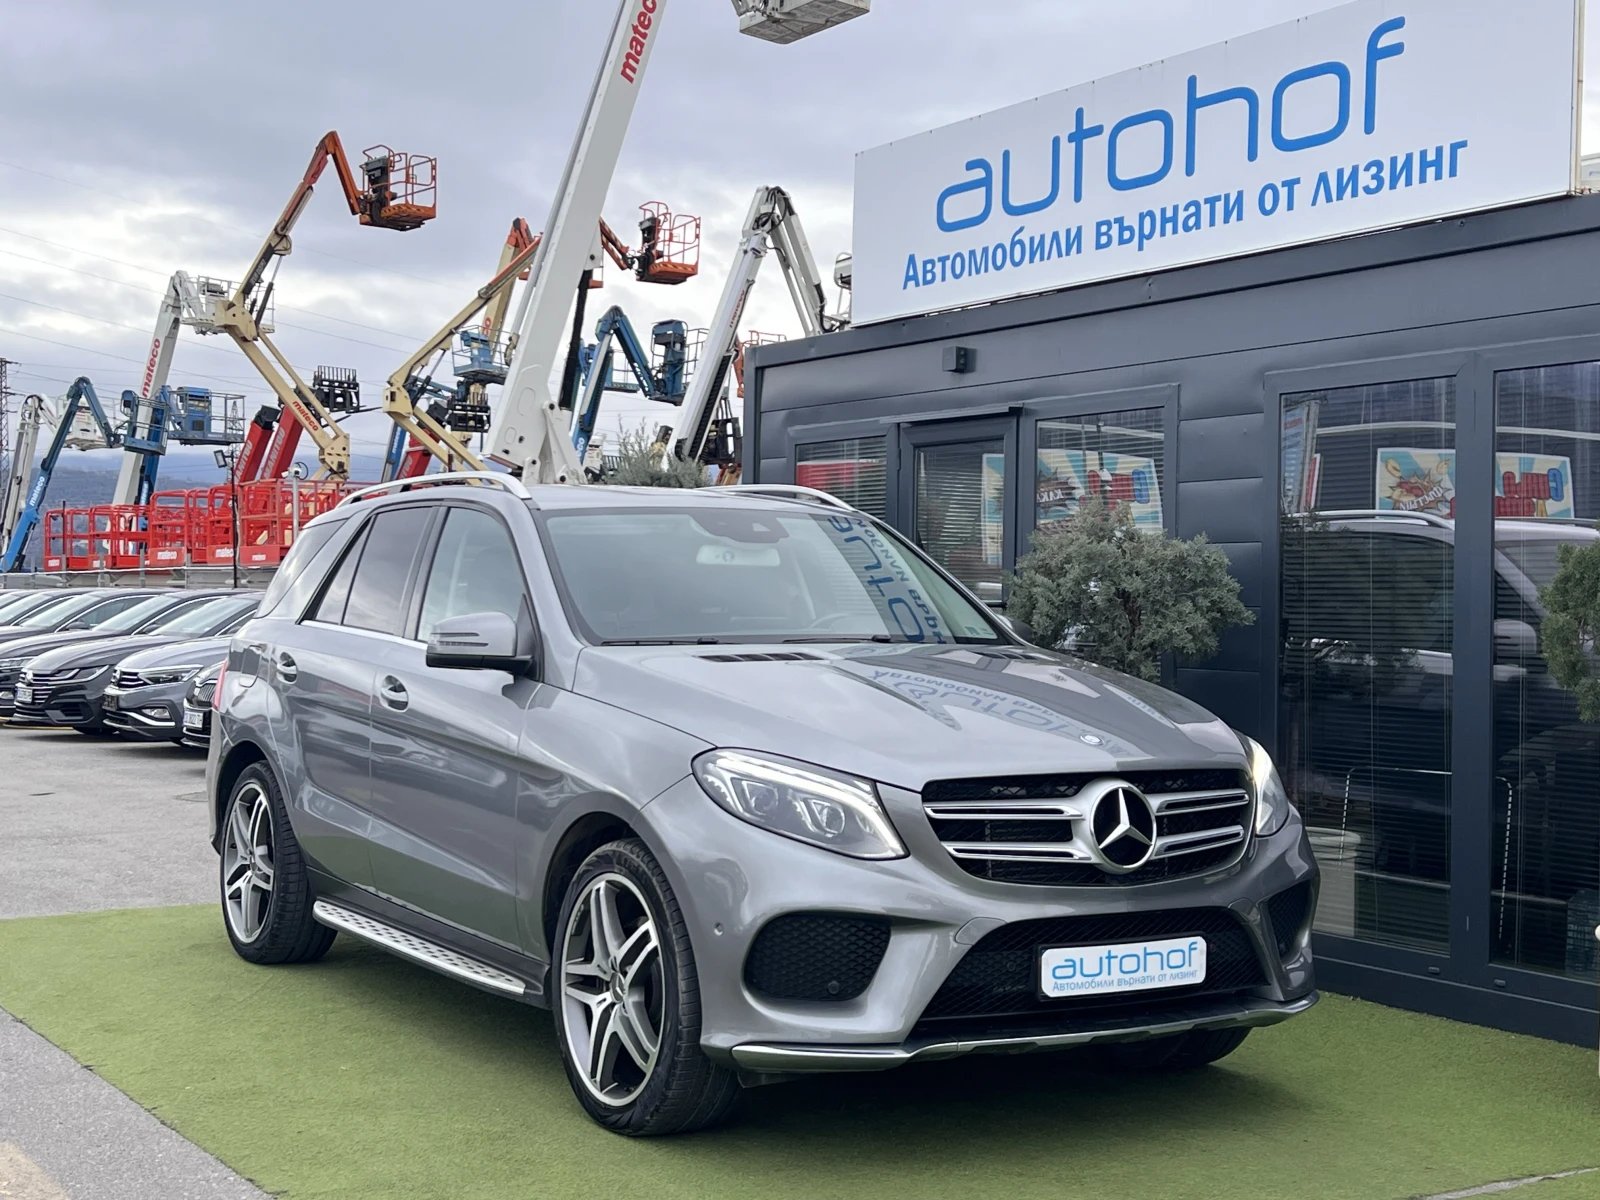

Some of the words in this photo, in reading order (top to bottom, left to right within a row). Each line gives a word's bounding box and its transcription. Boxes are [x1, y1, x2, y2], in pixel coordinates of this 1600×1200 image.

[937, 17, 1405, 232] autohof
[903, 226, 1082, 289] Автомобили
[1095, 190, 1243, 251] върнати
[1258, 178, 1301, 217] от
[1312, 140, 1468, 207] лизинг
[142, 338, 160, 398] mateco
[292, 401, 319, 431] mateco
[29, 476, 45, 506] mateco
[1052, 941, 1198, 980] autohof
[1053, 978, 1114, 991] Автомобили
[1117, 974, 1155, 987] върнати
[1157, 973, 1167, 982] от
[1169, 970, 1198, 981] лизинг
